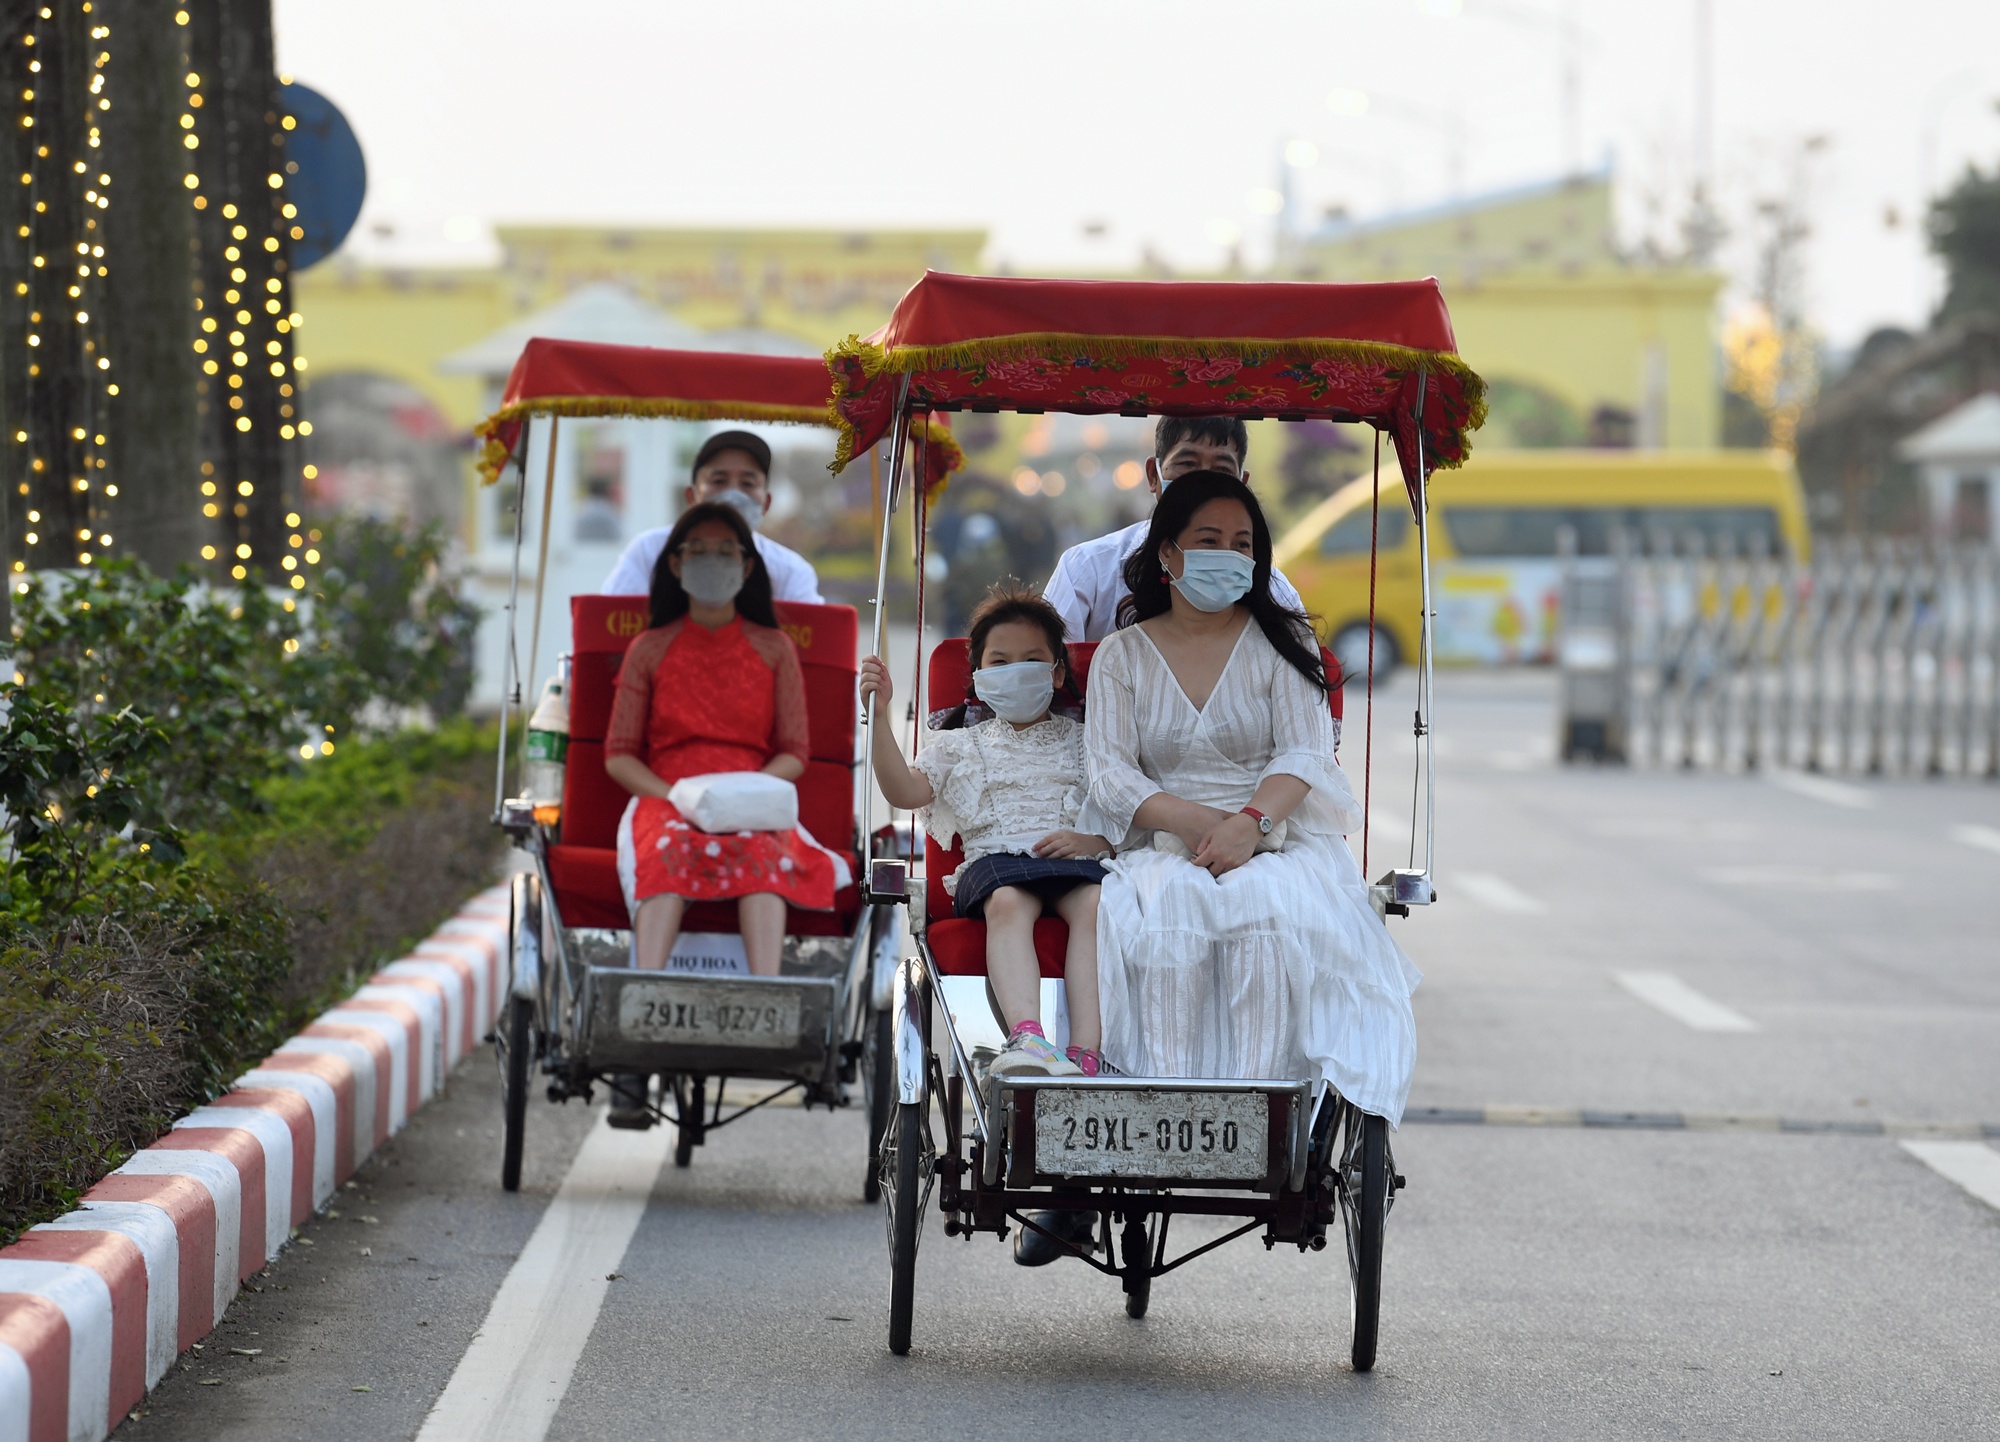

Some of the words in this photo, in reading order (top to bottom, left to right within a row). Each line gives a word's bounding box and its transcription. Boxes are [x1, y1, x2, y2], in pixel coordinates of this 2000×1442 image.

[670, 956, 697, 972] HỢ
[702, 957, 738, 971] HOA
[1062, 1116, 1239, 1153] 29XL-0050
